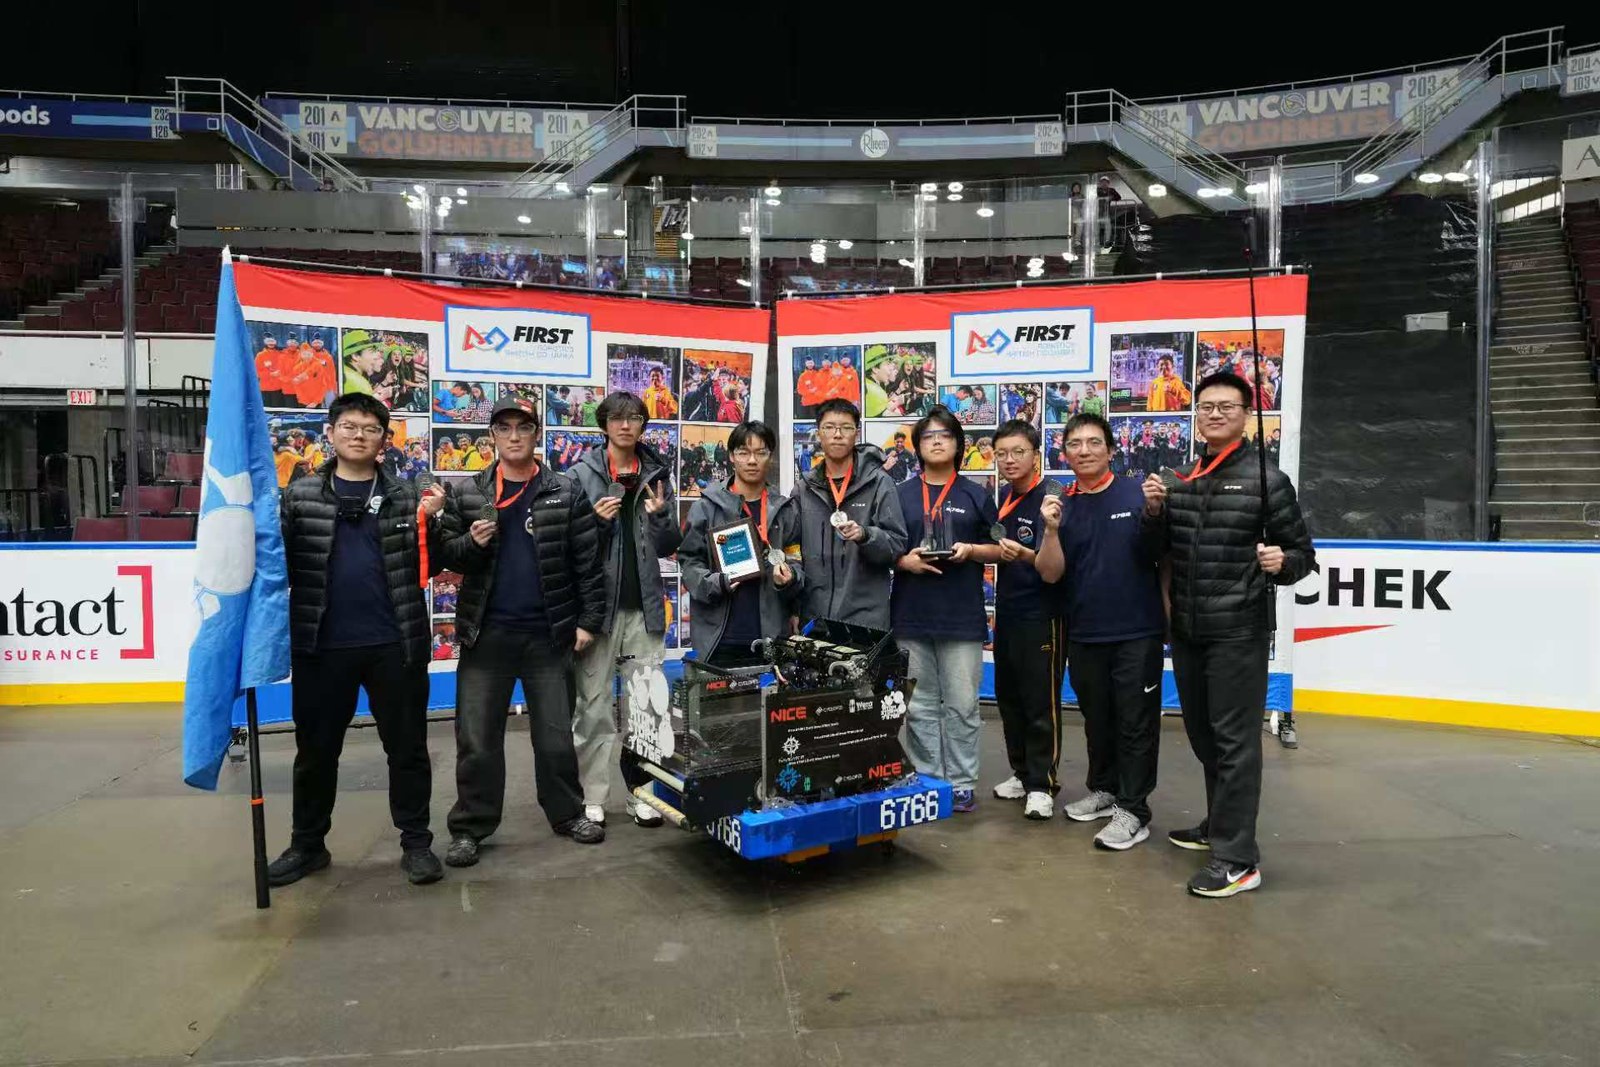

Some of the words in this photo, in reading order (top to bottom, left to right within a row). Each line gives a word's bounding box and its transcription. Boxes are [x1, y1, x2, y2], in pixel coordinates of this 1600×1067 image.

[304, 105, 325, 126] 201
[547, 114, 568, 134] 201
[1575, 144, 1600, 171] A
[513, 325, 574, 345] FIRST
[1014, 324, 1076, 343] FIRST
[70, 390, 93, 404] EXIT
[770, 706, 807, 723] NICE
[868, 762, 902, 779] NICE
[880, 789, 939, 830] 6766
